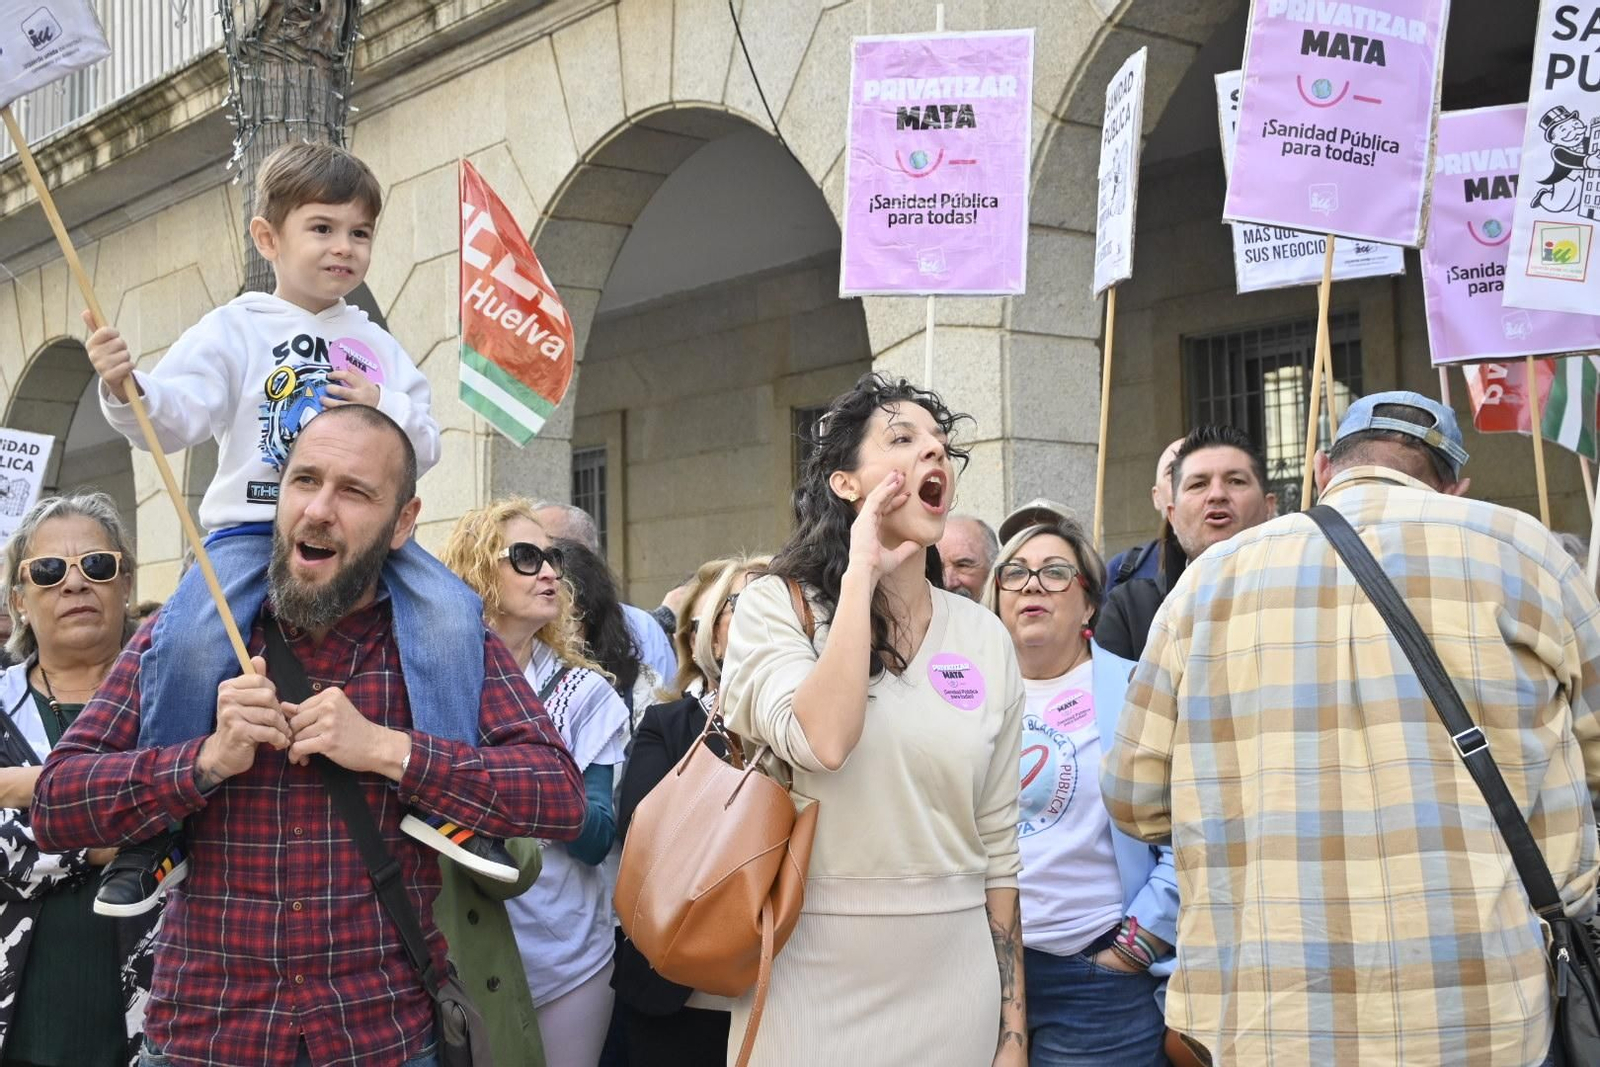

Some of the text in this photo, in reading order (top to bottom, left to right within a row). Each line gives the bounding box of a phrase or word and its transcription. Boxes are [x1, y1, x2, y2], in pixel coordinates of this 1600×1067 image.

[1267, 0, 1427, 45] PRIVATIZAR
[1300, 29, 1387, 67] MATA
[863, 75, 1018, 101] PRIVATIZAR
[896, 104, 977, 131] MATA
[1261, 119, 1338, 144] ¡Sanidad
[1340, 128, 1400, 154] Pública
[1281, 139, 1376, 167] para todas!
[869, 193, 999, 213] ¡Sanidad Pública
[888, 209, 978, 228] para todas!
[1245, 246, 1270, 264] SUS
[1446, 262, 1508, 285] ¡Sanida
[1468, 280, 1505, 297] para
[463, 278, 567, 362] Huelva
[1028, 719, 1067, 750] BLANCA
[1047, 764, 1073, 815] PÚBLICA
